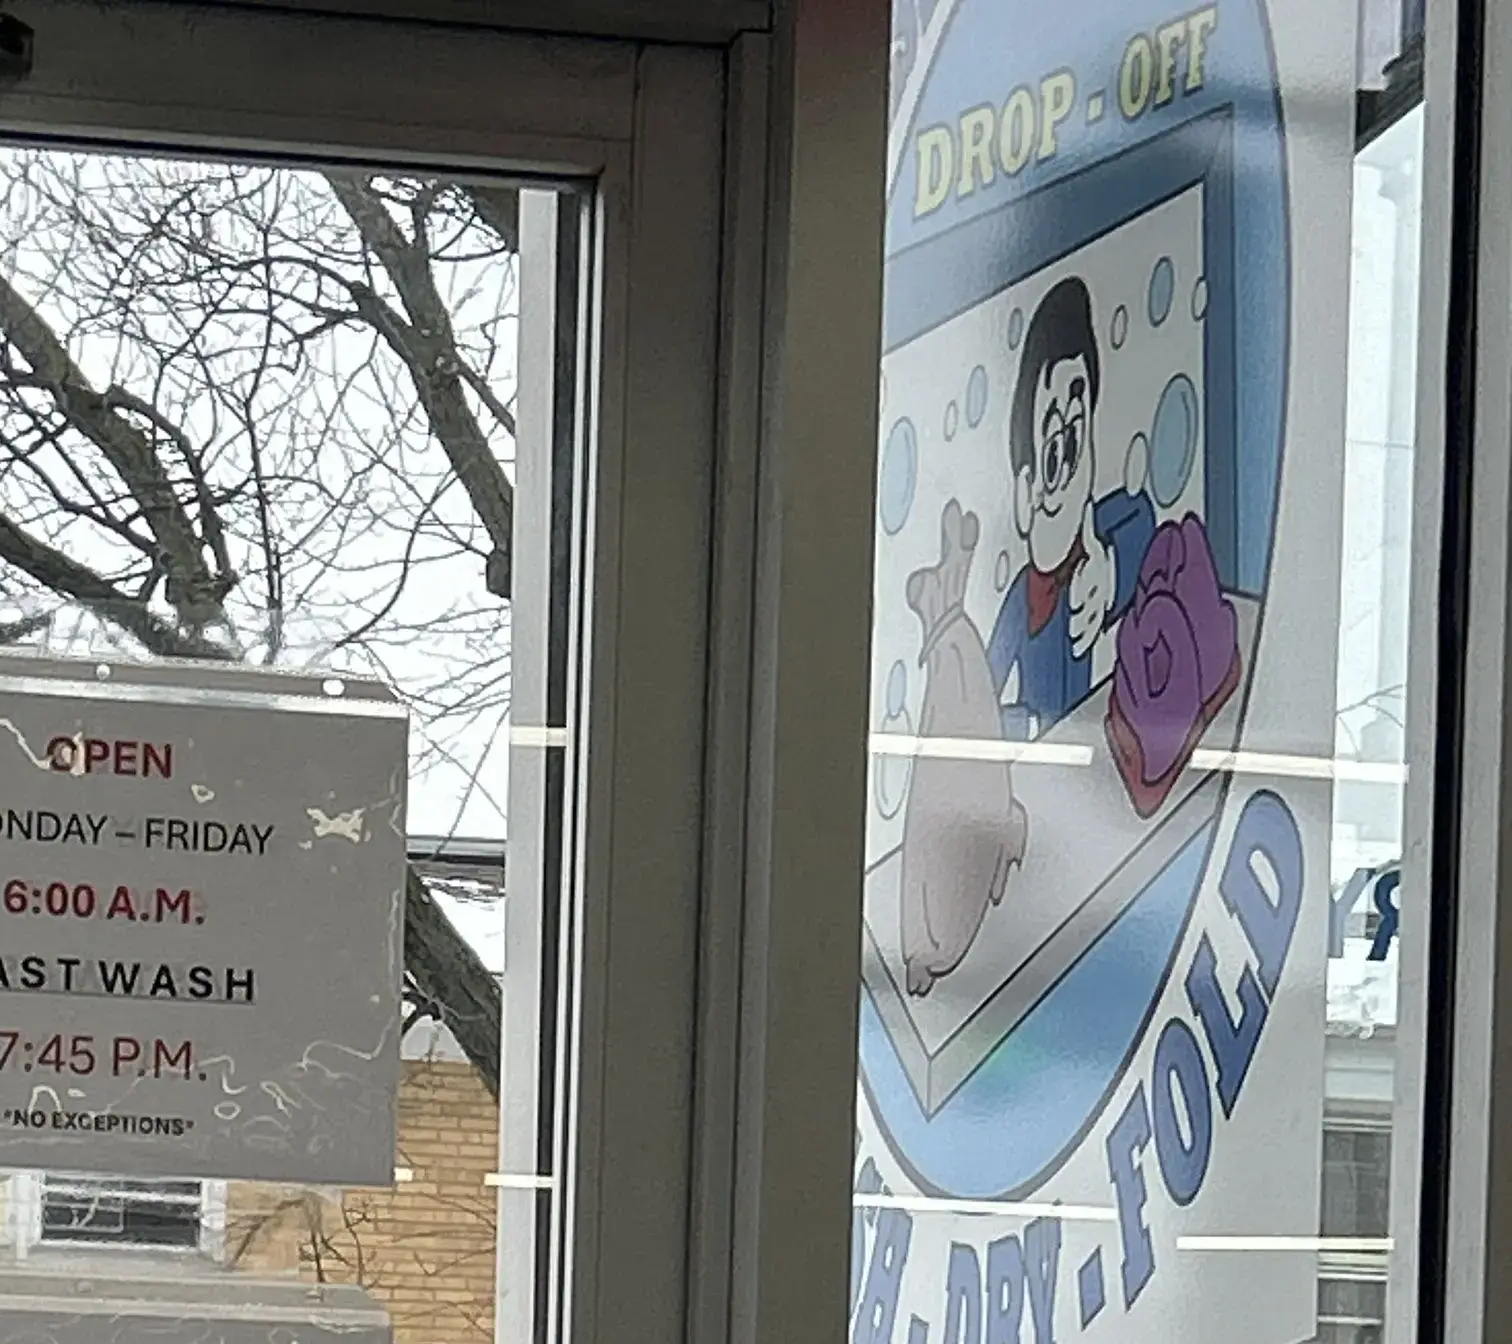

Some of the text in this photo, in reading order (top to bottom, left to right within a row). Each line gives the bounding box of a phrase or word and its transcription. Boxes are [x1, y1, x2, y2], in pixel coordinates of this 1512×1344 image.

[46, 736, 172, 778] OPEN
[146, 818, 274, 856] FRIDAY
[4, 880, 205, 925] 6:00 A.M.
[99, 961, 254, 1001] WASH
[113, 1037, 207, 1081] P.M.
